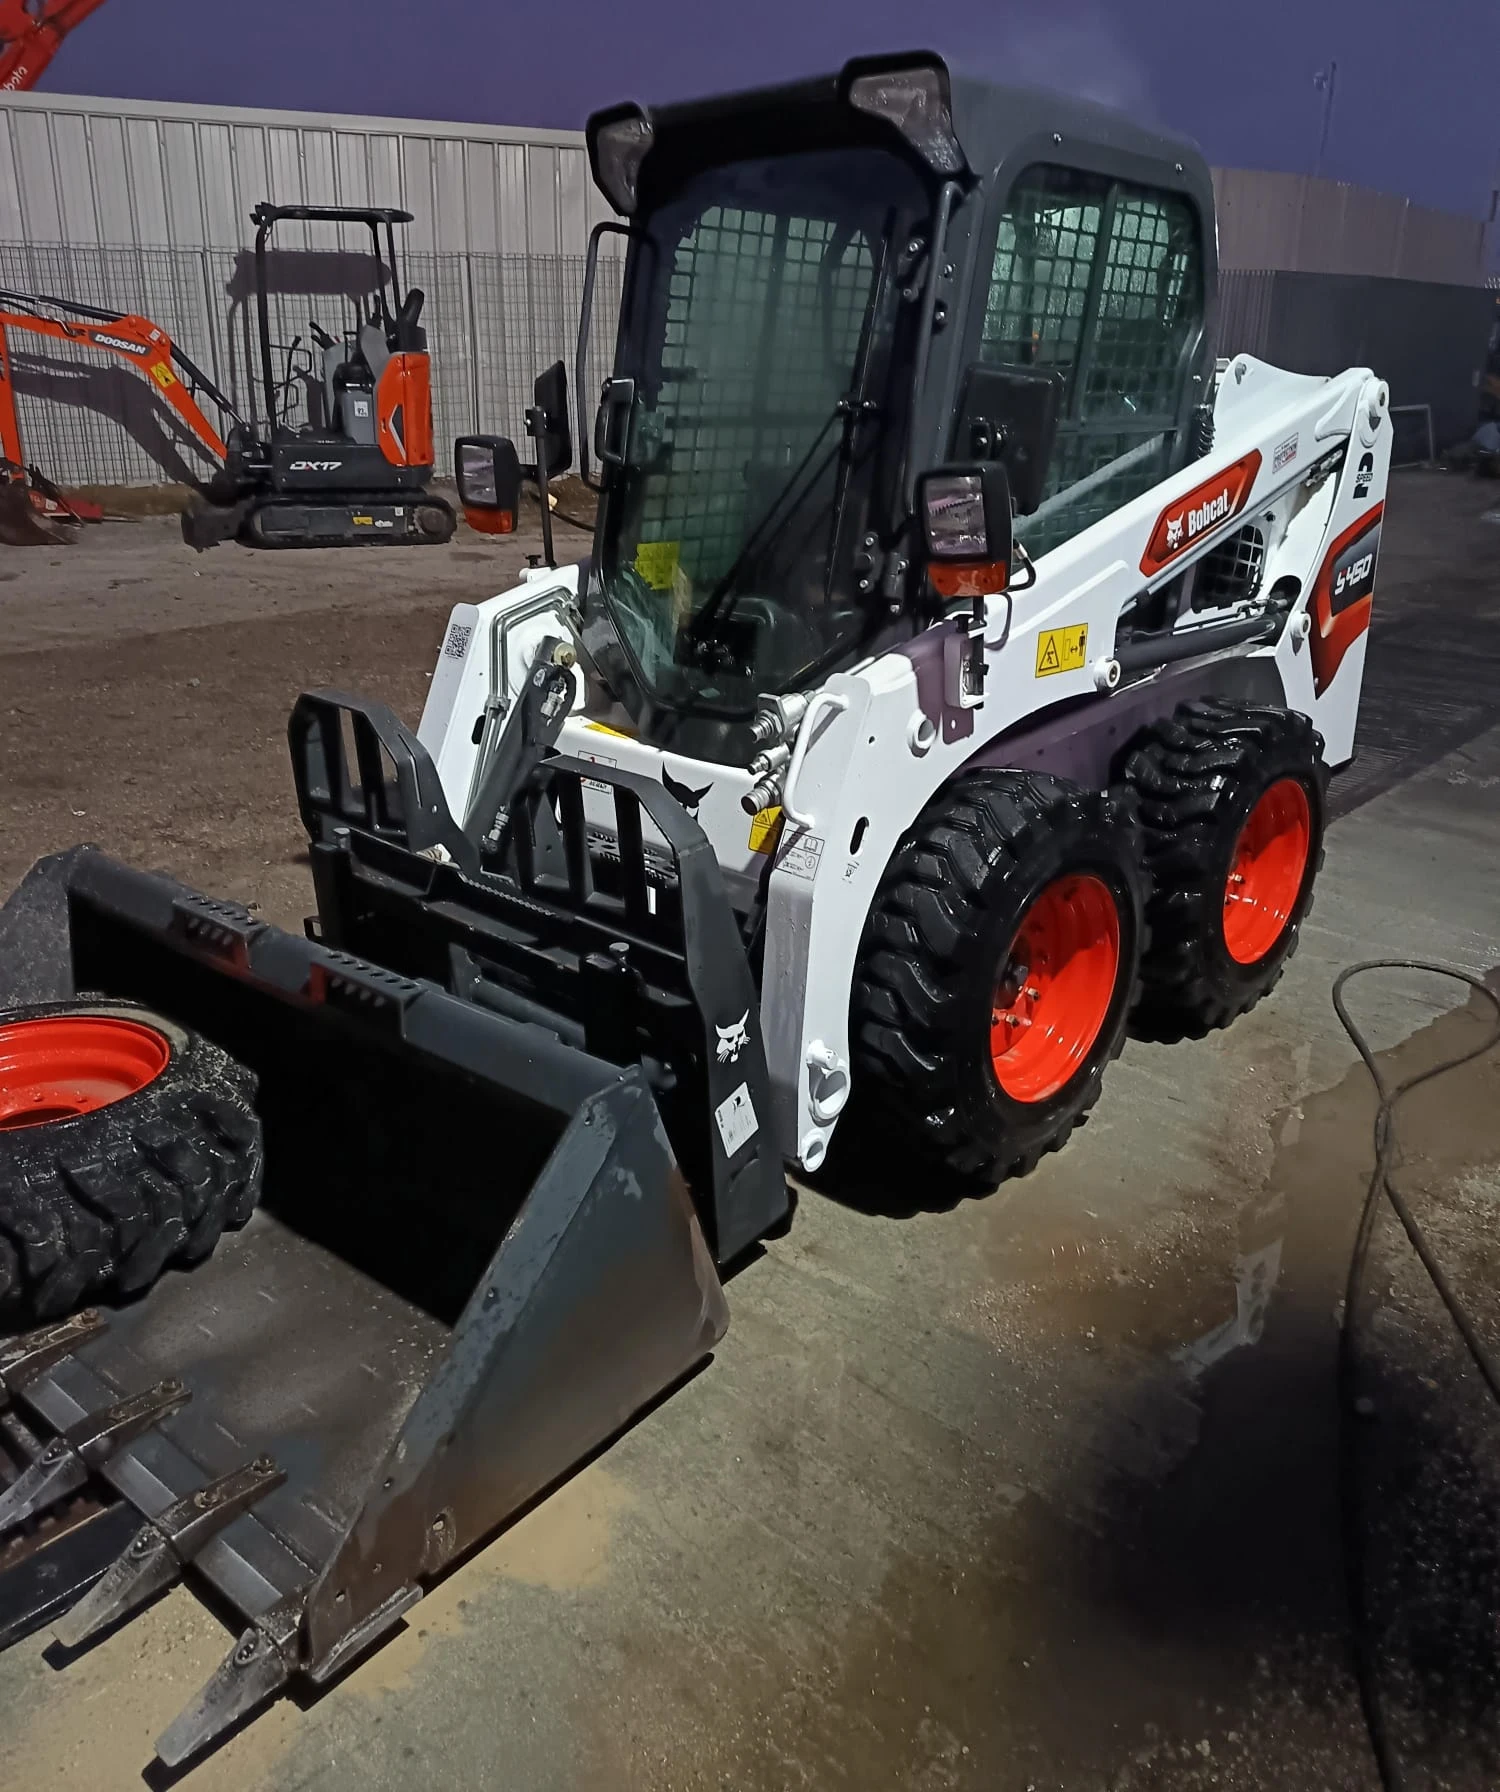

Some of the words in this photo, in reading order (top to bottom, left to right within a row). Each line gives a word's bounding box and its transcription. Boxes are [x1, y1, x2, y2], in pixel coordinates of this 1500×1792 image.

[95, 333, 146, 354] DOOSAN
[290, 461, 342, 471] DX17
[1353, 452, 1373, 499] 2
[1355, 472, 1374, 483] SPEED
[1188, 488, 1228, 537] Bobcat
[1334, 553, 1373, 596] S450
